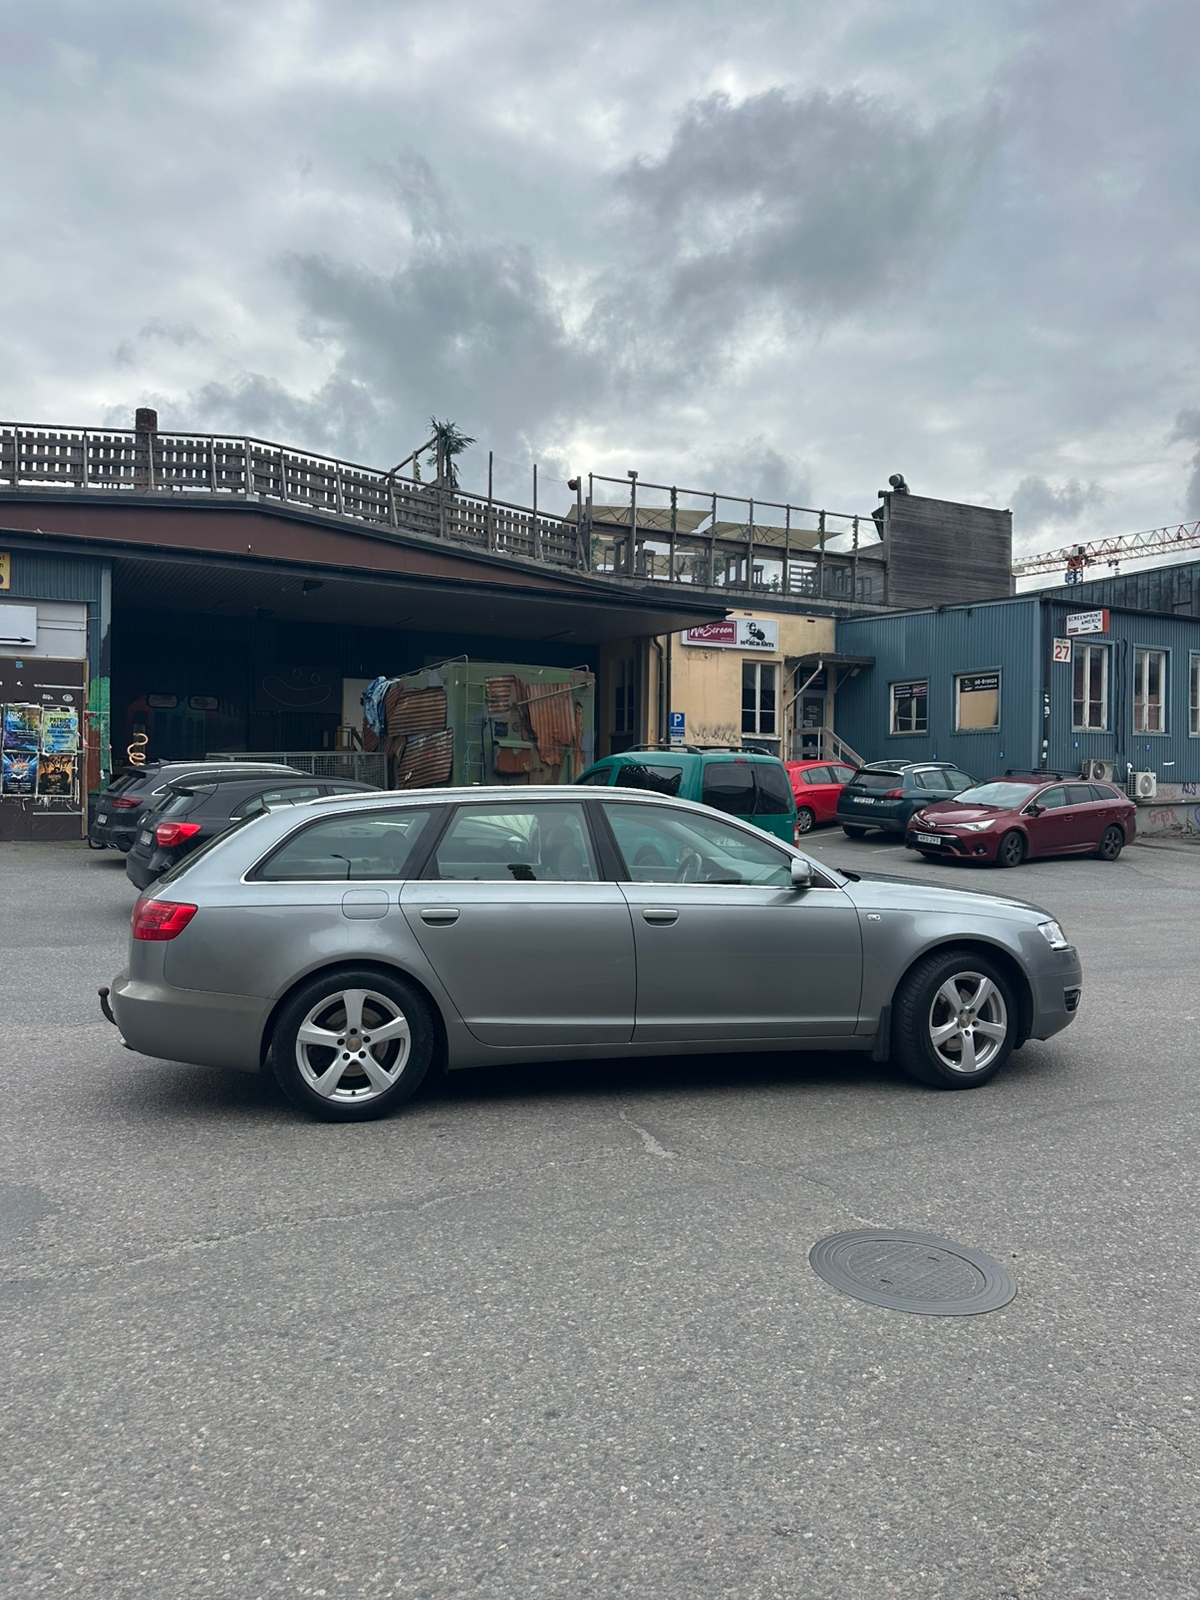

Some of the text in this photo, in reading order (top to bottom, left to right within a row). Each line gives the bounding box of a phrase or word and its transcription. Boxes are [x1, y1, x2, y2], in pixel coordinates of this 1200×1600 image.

[1068, 612, 1101, 622] SCREENPRINT
[1055, 645, 1069, 660] 27
[674, 713, 682, 726] P
